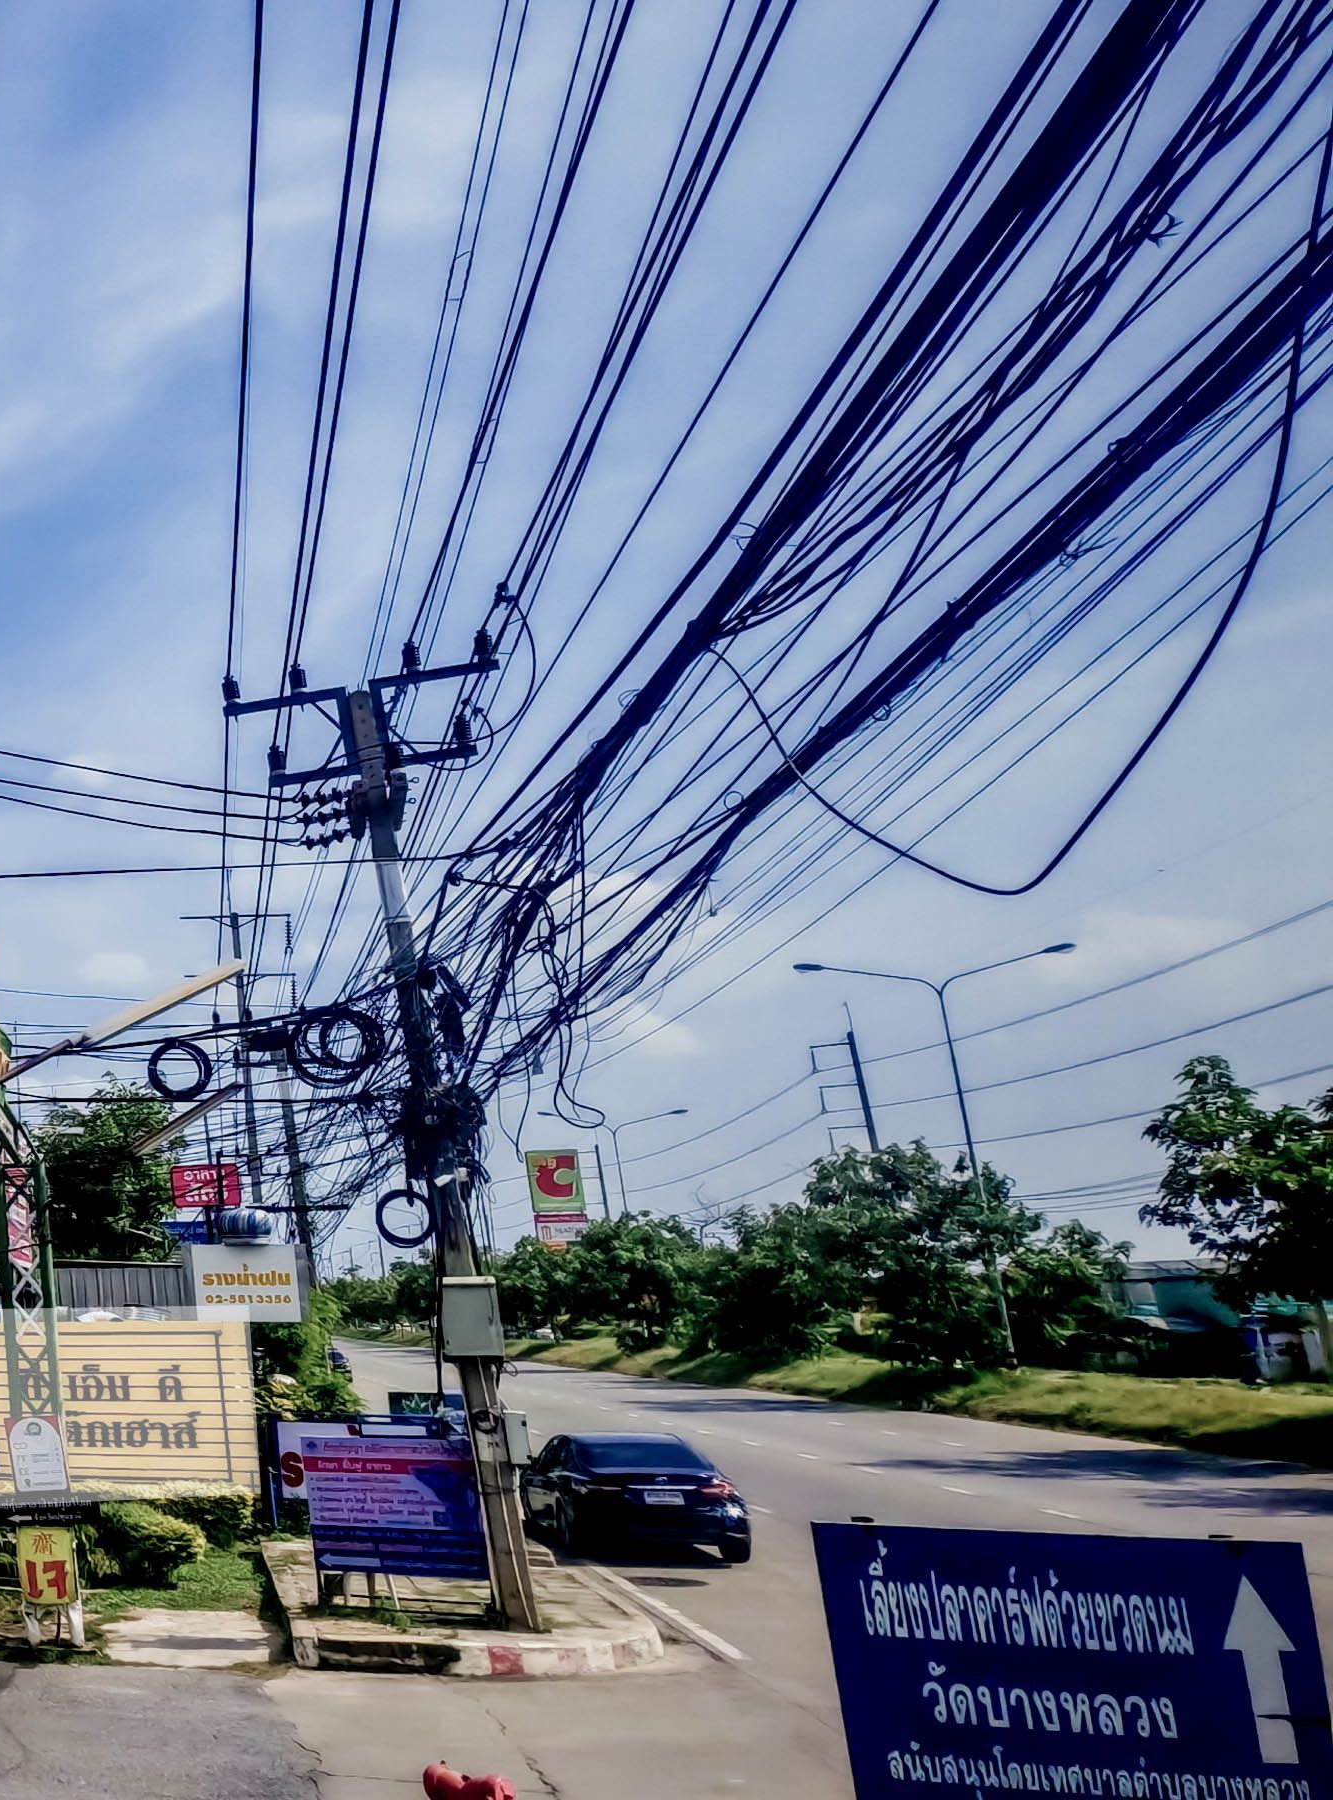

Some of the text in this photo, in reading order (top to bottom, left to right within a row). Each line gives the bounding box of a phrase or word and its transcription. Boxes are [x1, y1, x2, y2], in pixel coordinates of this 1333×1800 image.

[202, 1263, 291, 1286] รางน้ำฝน
[25, 1560, 68, 1599] เจ
[859, 1539, 1194, 1655] เลี้ยงปลาคาร์ฟด้วยขวดนม
[922, 1661, 1179, 1739] วัดบางหลวง
[886, 1740, 1311, 1800] สนับสนุนโดยเทศบาลตำบลบางหลวง
